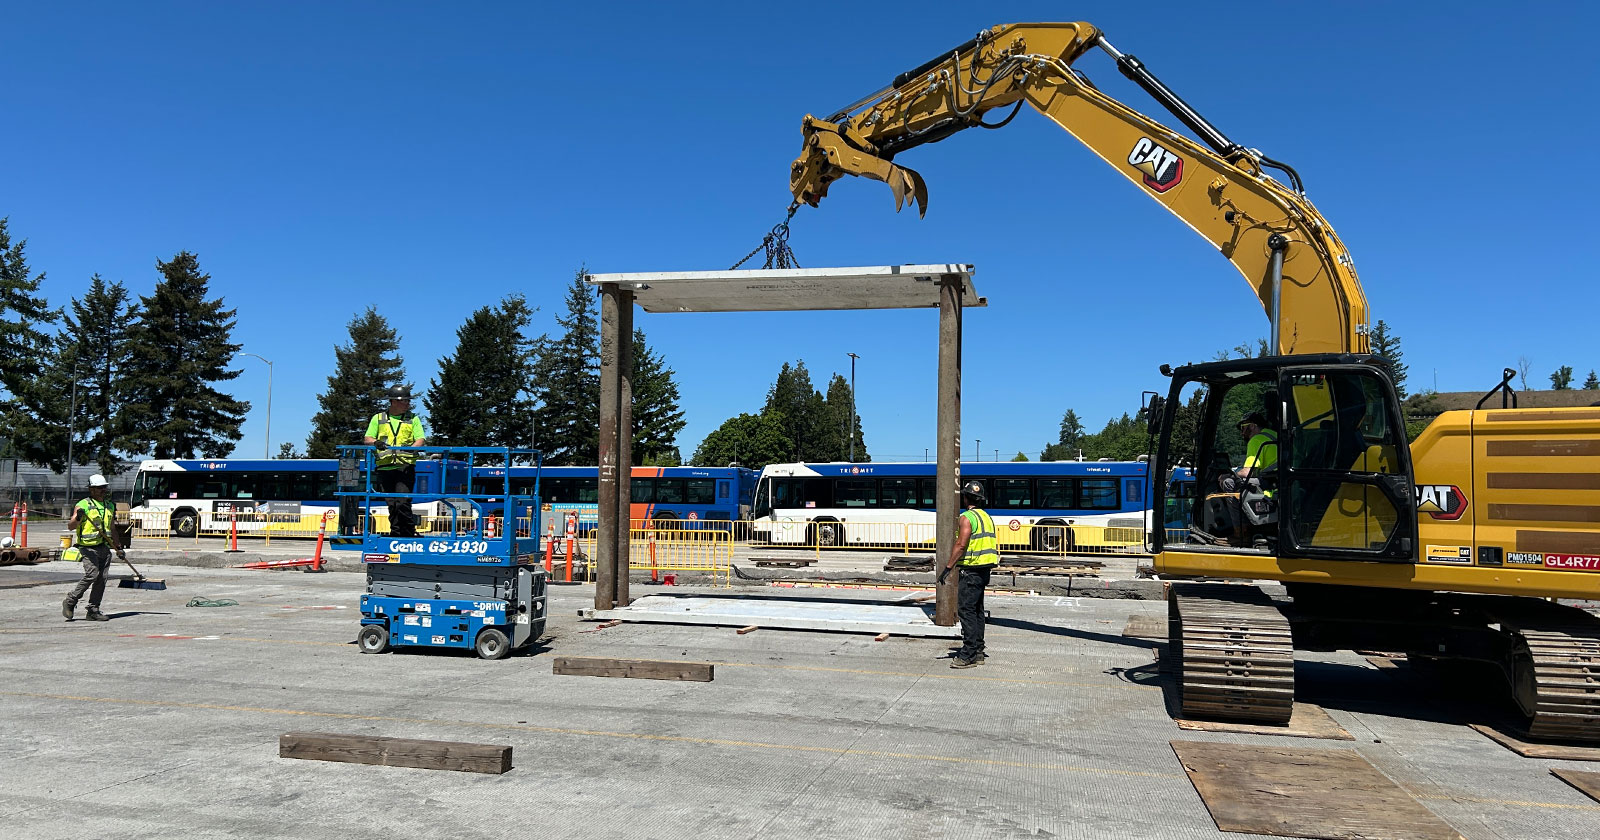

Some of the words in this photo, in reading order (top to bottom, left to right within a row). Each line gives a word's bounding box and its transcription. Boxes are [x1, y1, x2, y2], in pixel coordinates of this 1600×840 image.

[1128, 137, 1179, 181] CAT
[389, 541, 424, 553] Genie
[429, 541, 488, 554] GS-1930
[1507, 552, 1542, 562] PM01504
[1545, 555, 1600, 568] GL4R77
